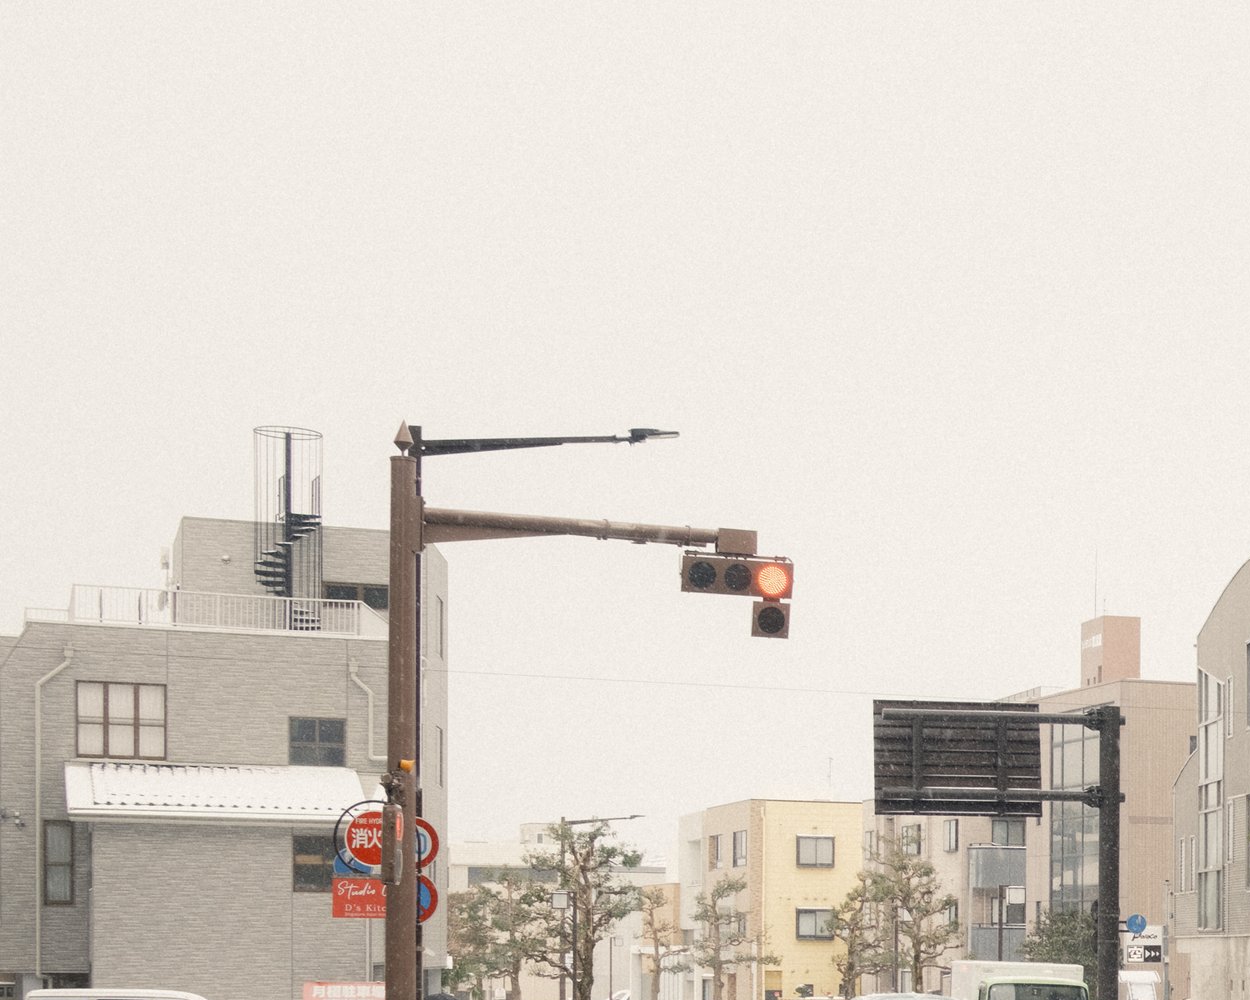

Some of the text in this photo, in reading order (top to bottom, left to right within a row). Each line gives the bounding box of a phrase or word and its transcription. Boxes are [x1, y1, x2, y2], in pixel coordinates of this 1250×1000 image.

[352, 828, 382, 848] 消火
[338, 881, 376, 900] Studio
[1129, 946, 1143, 959] 空
